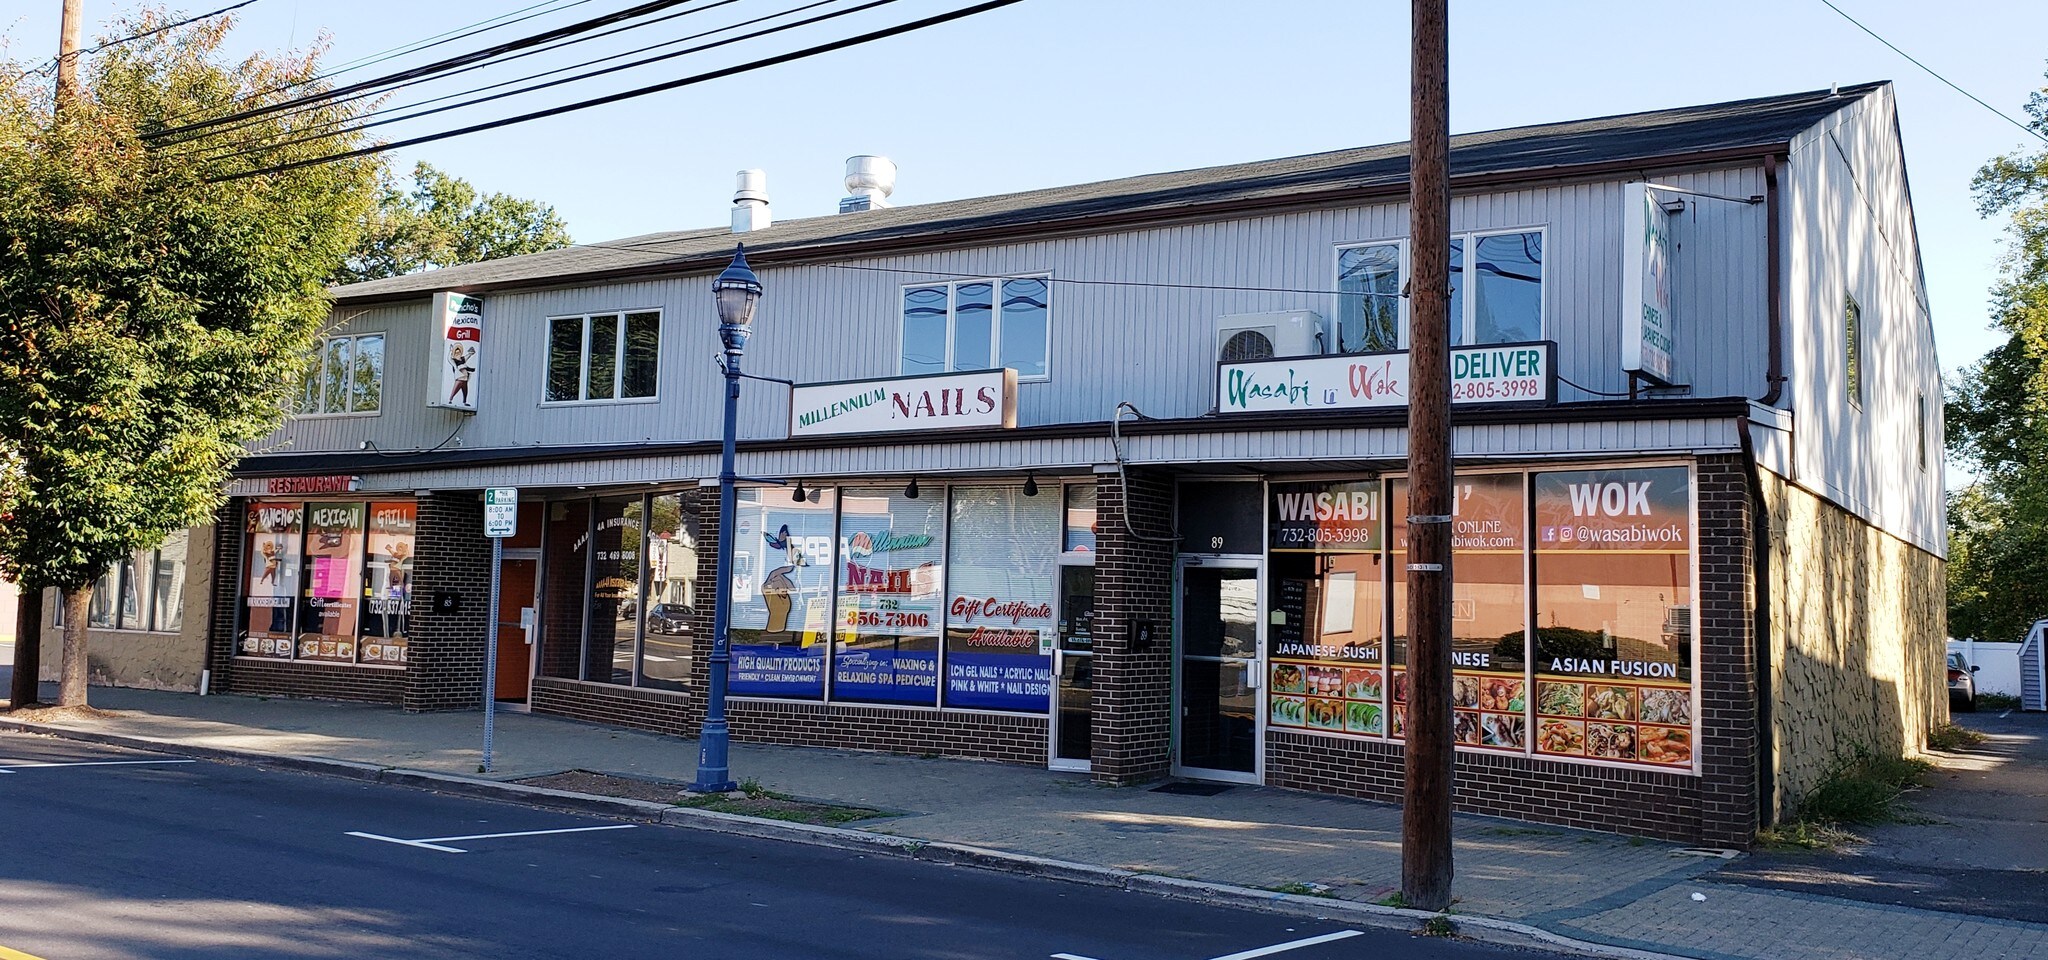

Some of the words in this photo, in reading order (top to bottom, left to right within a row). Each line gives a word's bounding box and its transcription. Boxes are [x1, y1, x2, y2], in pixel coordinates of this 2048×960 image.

[456, 329, 471, 340] Grill
[1454, 350, 1540, 380] DELIVER
[1228, 368, 1313, 409] Wasabi
[1349, 360, 1405, 400] Wok
[1453, 379, 1538, 400] 2-805-3998
[799, 387, 886, 429] MILLENNIUM
[891, 386, 996, 419] NAILS
[268, 475, 350, 493] RESTAURANT
[488, 492, 494, 502] 2
[1568, 481, 1652, 517] WOK
[1277, 491, 1377, 521] WASABI
[258, 507, 302, 529] PANCHO'S
[313, 507, 359, 529] MEXICAN
[377, 509, 411, 528] GRILL
[606, 517, 640, 531] INSURANCE
[1458, 520, 1502, 533] ONLINE
[1282, 528, 1368, 543] 732-805-3998
[1576, 524, 1683, 542] @wasabiwok
[849, 530, 934, 558] Millennium
[1211, 537, 1223, 549] 89
[596, 551, 607, 560] 732
[846, 560, 936, 595] NAILS
[309, 597, 324, 608] Gift
[879, 599, 898, 610] 732
[951, 596, 981, 623] Gift
[983, 596, 1052, 624] Certificate
[847, 611, 929, 628] 356-7306
[967, 625, 1035, 647] Available
[1276, 643, 1379, 660] JAPANESE/SUSHI
[1451, 651, 1490, 668] NESE
[738, 656, 755, 670] HIGH
[756, 657, 782, 671] QUALITY
[783, 658, 821, 672] PRODUCTS
[892, 658, 927, 671] WAXING
[928, 660, 935, 671] &
[950, 664, 964, 677] LCN
[965, 665, 978, 677] GEL
[979, 666, 998, 678] NAILS
[1004, 667, 1033, 680] ACRYLIC
[1550, 657, 1605, 674] ASIAN
[1610, 660, 1677, 678] FUSION
[738, 672, 761, 681] FRIENDLY
[765, 673, 780, 682] CLEAN
[837, 671, 877, 684] RELAXING
[878, 673, 894, 685] SPA
[896, 674, 936, 687] PEDICURE
[950, 679, 969, 692] PINK
[969, 680, 976, 692] &
[977, 680, 999, 693] WHITE
[1006, 682, 1024, 694] NAIL
